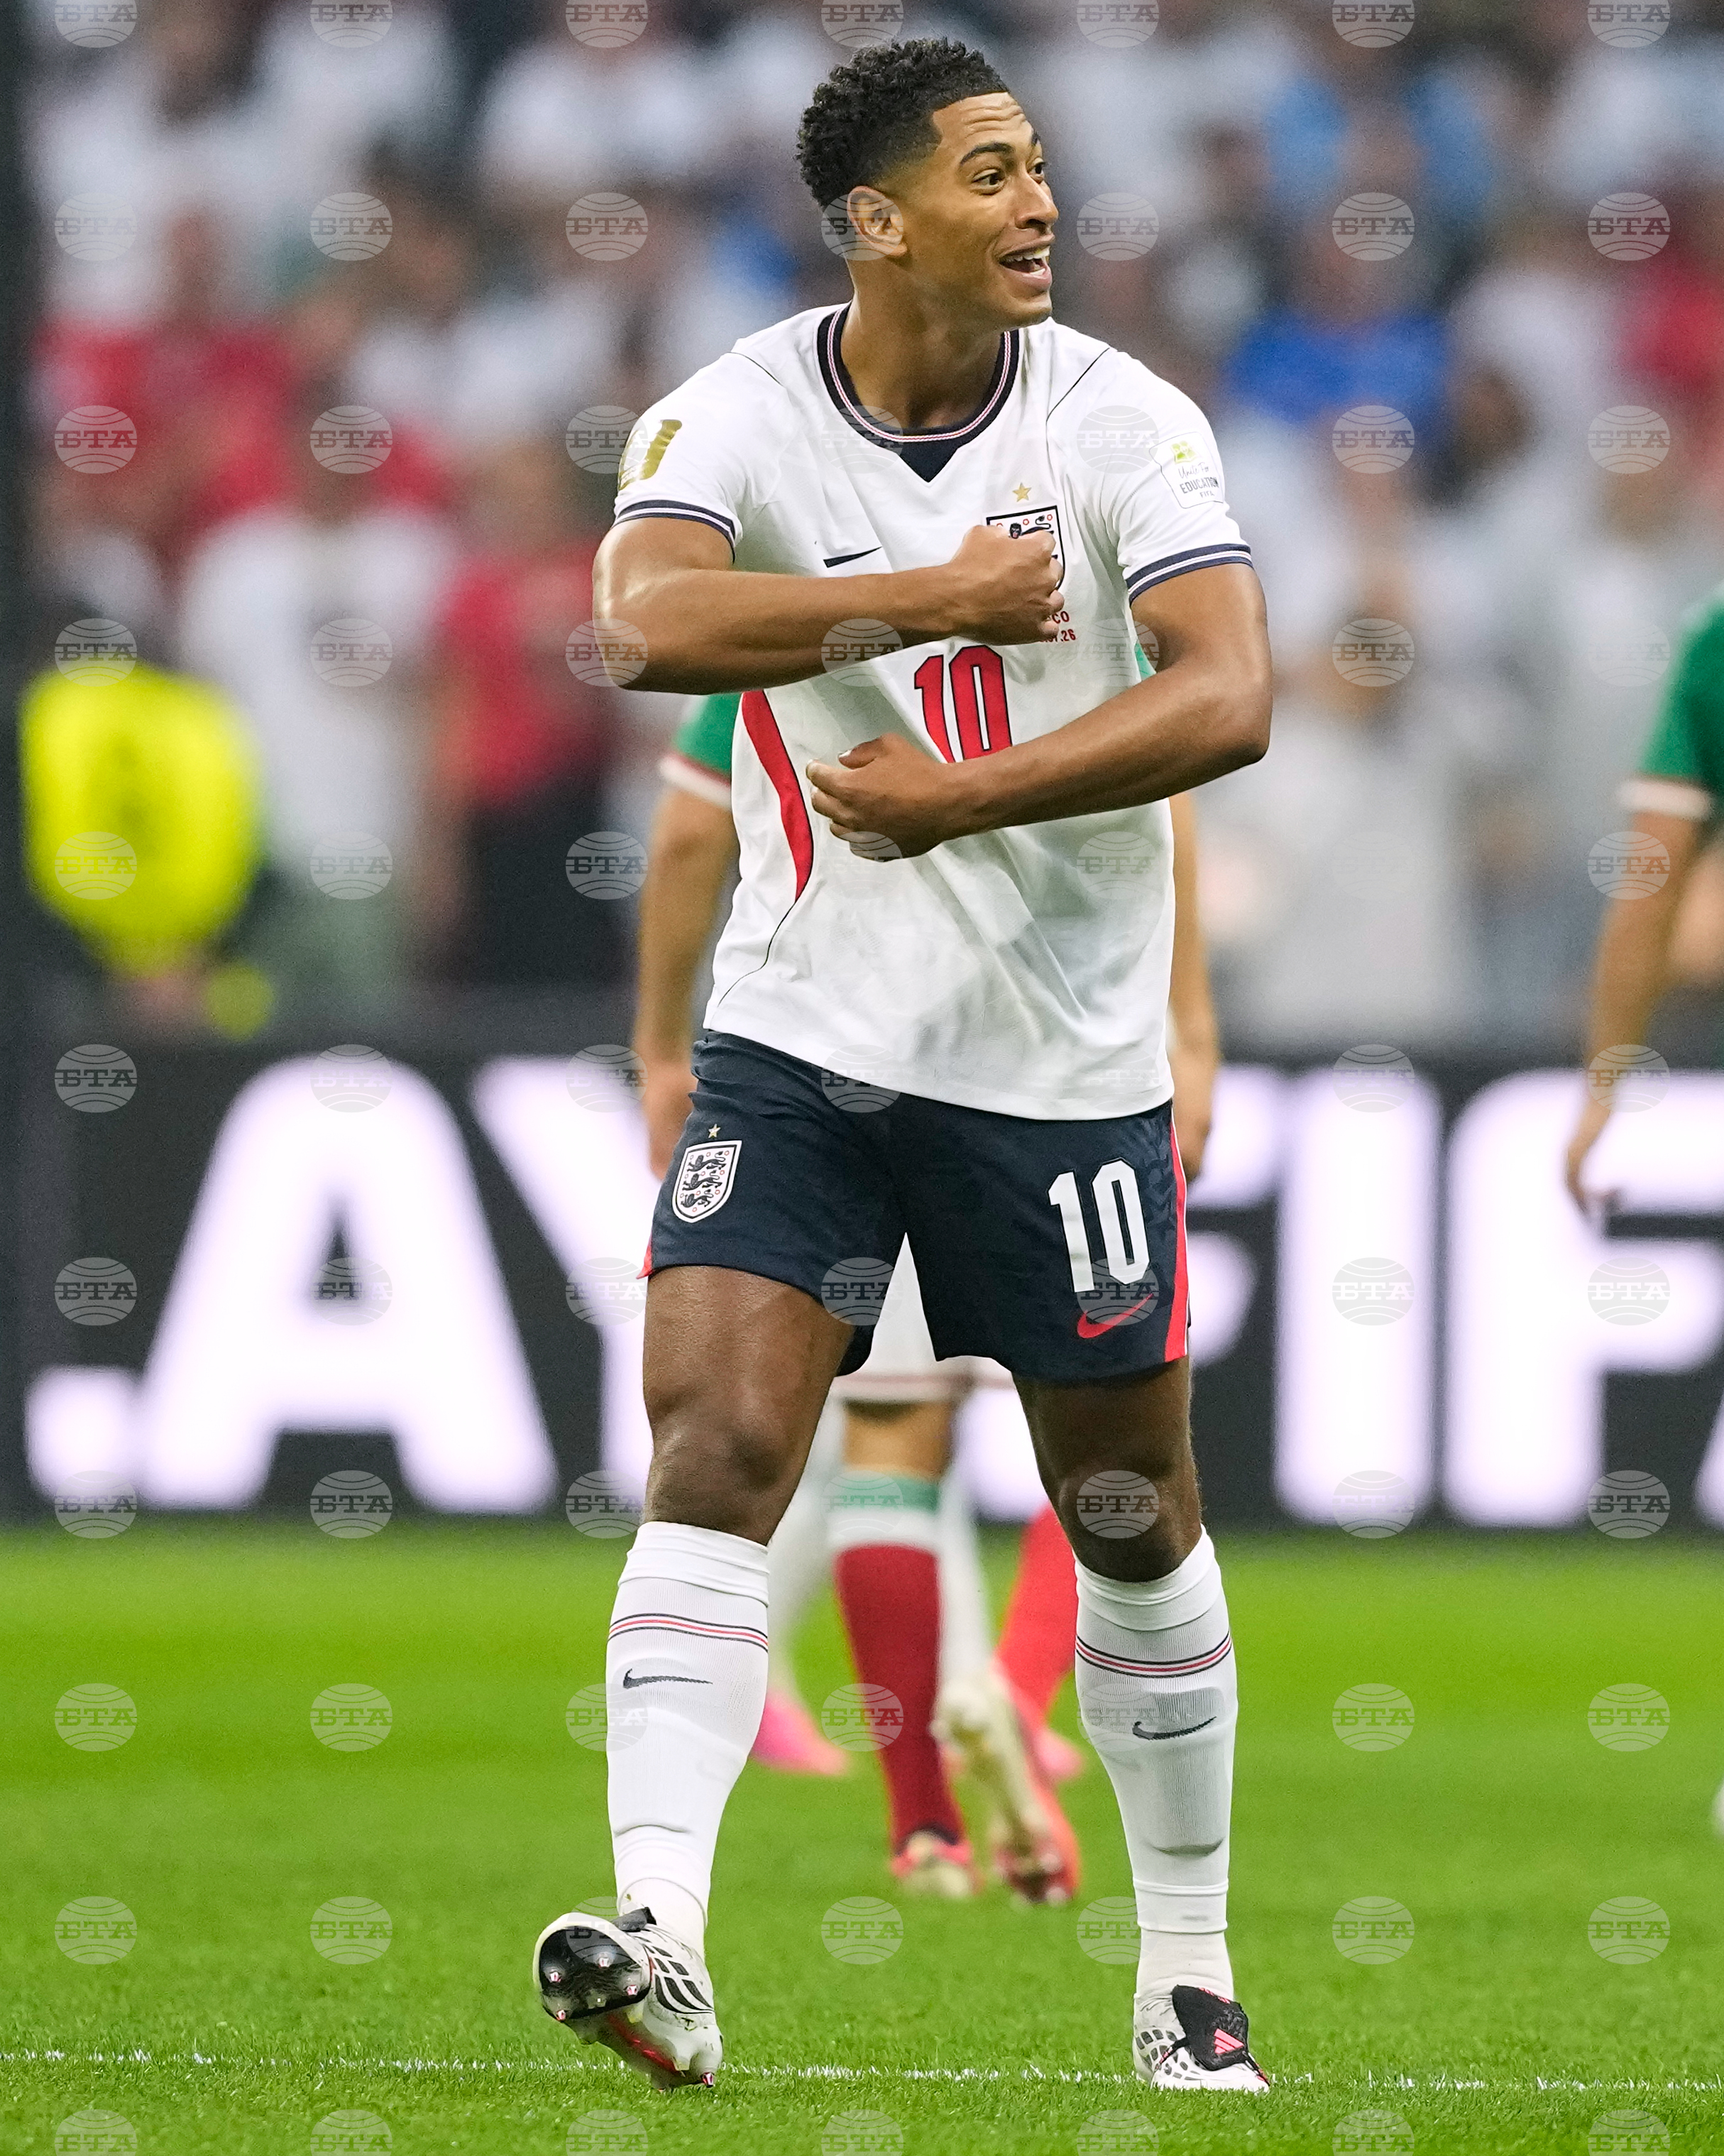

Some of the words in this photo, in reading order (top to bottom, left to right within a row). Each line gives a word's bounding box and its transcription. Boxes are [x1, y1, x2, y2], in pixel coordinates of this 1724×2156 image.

[1051, 611, 1070, 624] CO
[914, 645, 1013, 764] 10
[1047, 1156, 1151, 1293] 10
